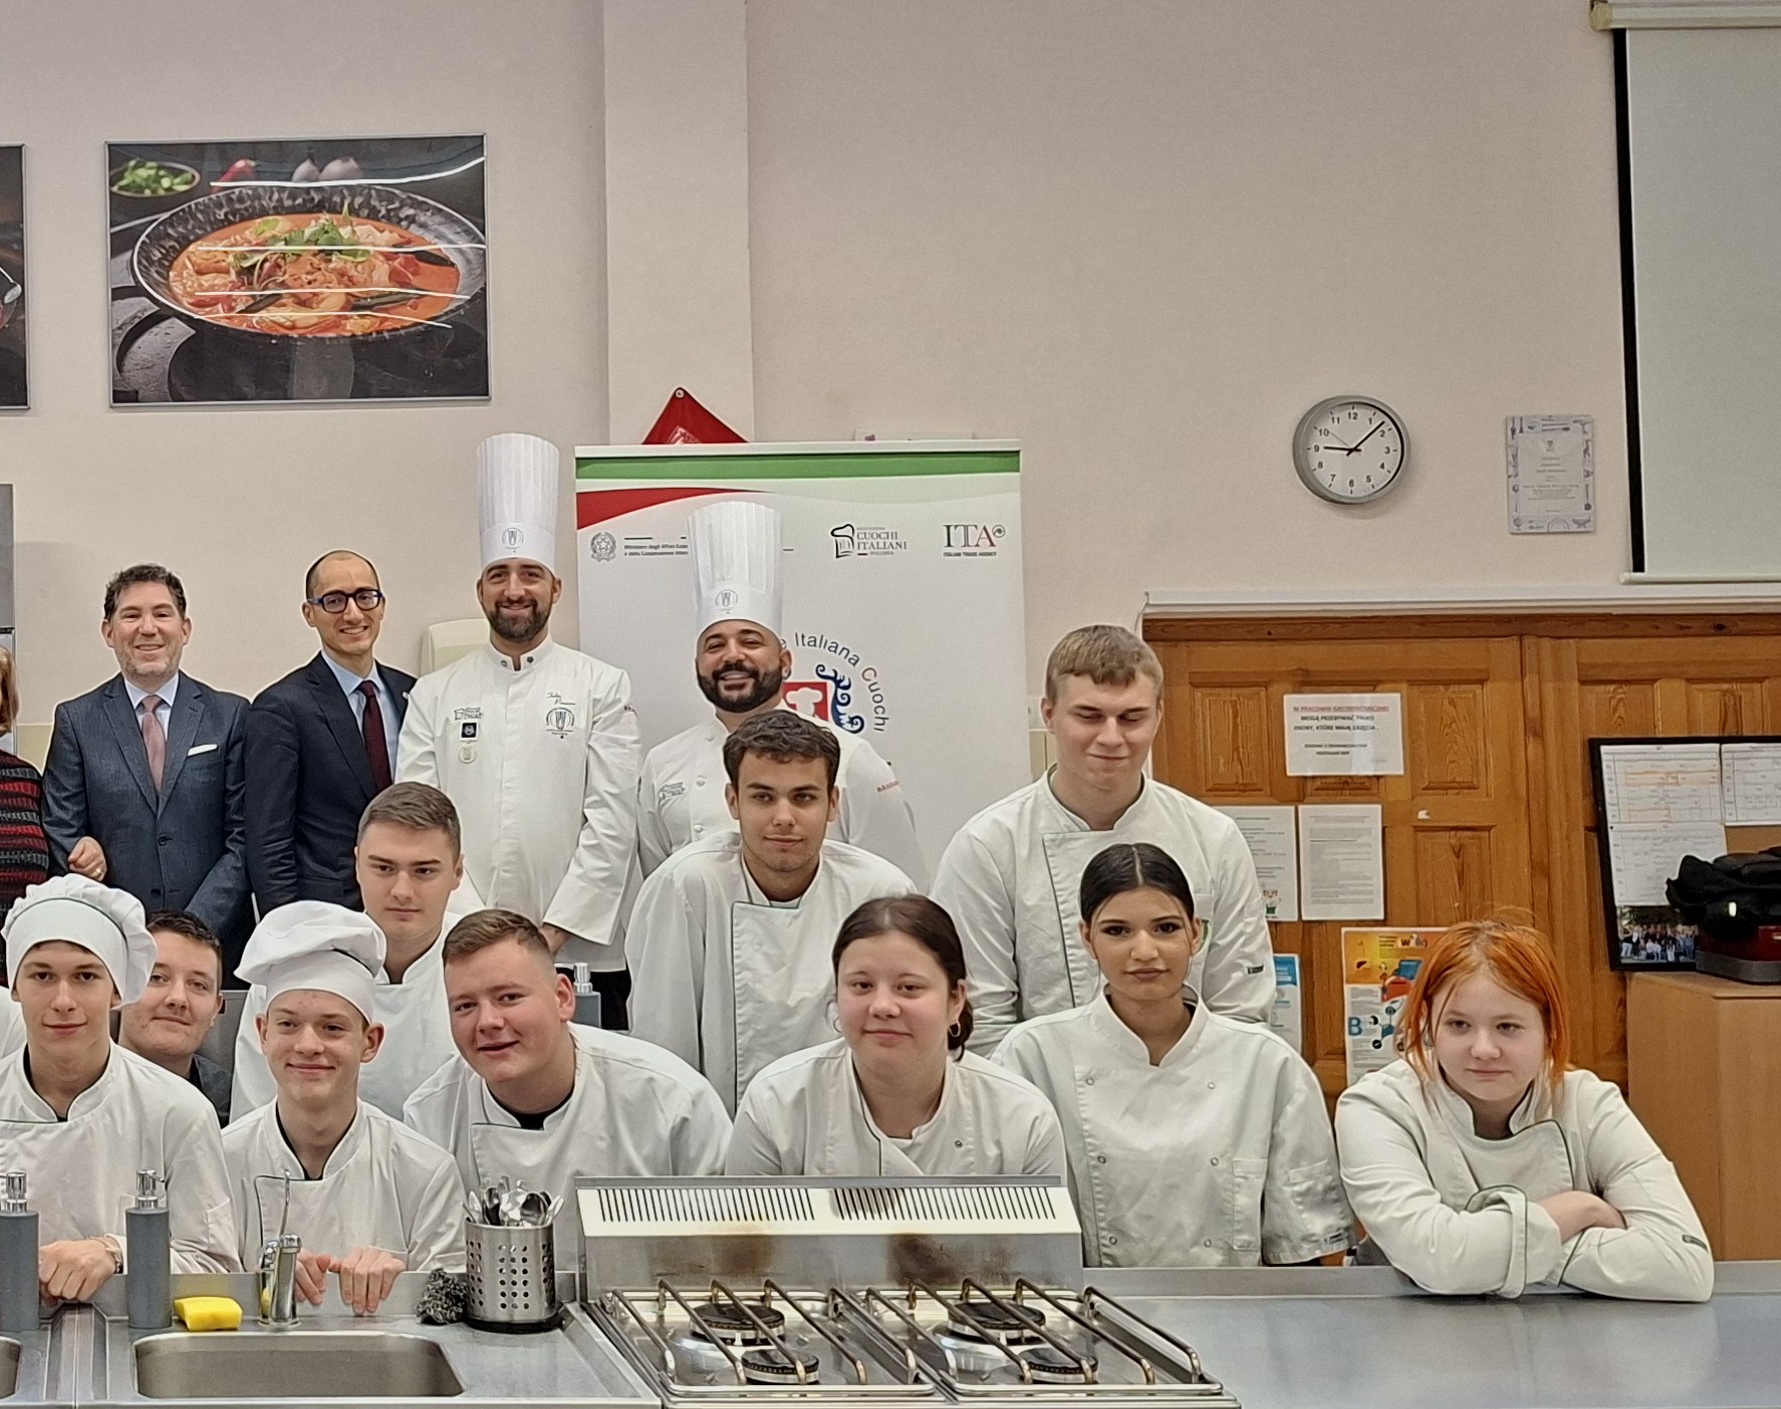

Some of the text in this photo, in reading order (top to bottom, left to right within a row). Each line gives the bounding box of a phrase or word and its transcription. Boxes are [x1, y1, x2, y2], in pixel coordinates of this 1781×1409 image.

[1348, 411, 1358, 420] 12
[1331, 416, 1340, 425] 11
[1318, 428, 1330, 437] 10
[1379, 430, 1386, 438] 2
[1313, 444, 1320, 453] 9
[1384, 446, 1391, 454] 3
[1317, 461, 1324, 469] 8
[1330, 473, 1336, 482] 7
[1366, 475, 1372, 483] 5
[1349, 479, 1355, 487] 6
[857, 531, 898, 541] CUOCHI
[942, 524, 997, 548] ITA
[857, 541, 908, 550] ITALIANI
[794, 632, 861, 668] Italiana
[861, 667, 890, 732] Cuochi
[1348, 1016, 1363, 1037] B
